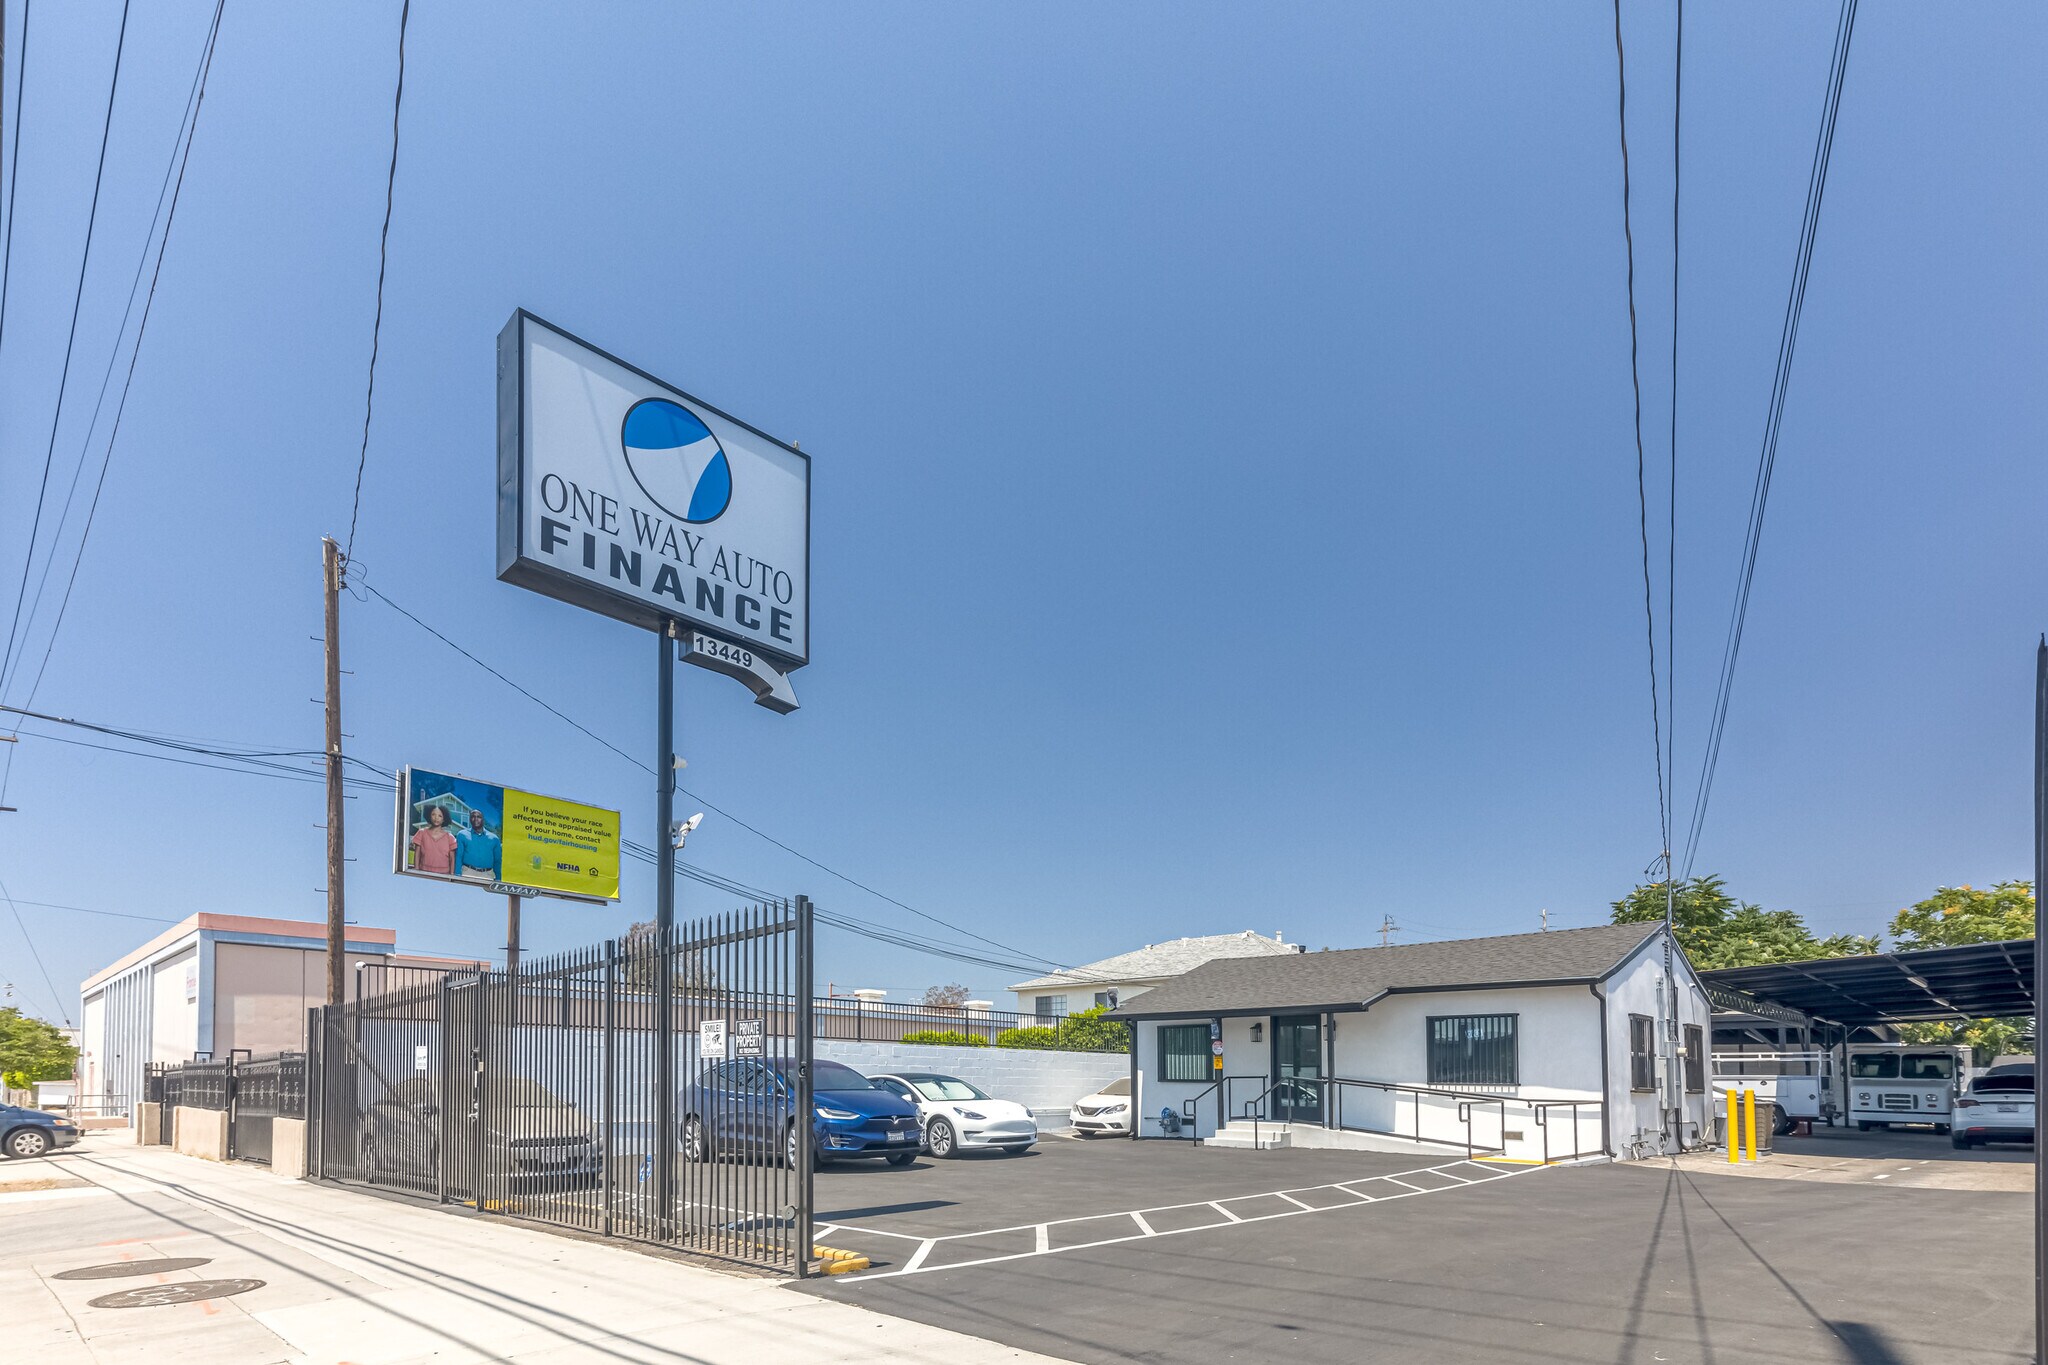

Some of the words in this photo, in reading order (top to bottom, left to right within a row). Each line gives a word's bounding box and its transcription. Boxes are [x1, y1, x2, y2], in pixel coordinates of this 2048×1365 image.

[540, 473, 620, 536] ONE
[629, 506, 704, 568] WAY
[709, 544, 793, 605] AUTO
[540, 515, 793, 644] FINANCE
[696, 636, 753, 668] 13449
[530, 808, 544, 816] you
[545, 810, 570, 821] believe
[571, 816, 587, 824] your
[512, 813, 543, 824] affected
[545, 819, 557, 827] the
[558, 823, 592, 834] appraised
[593, 829, 612, 838] value
[528, 833, 598, 852] hud.gov/fairhousing
[534, 826, 550, 834] your
[552, 829, 574, 839] home,
[575, 835, 601, 844] contact
[494, 884, 538, 895] LAMAR
[739, 1022, 759, 1034] PRIVATE
[736, 1035, 762, 1047] PROPERTY
